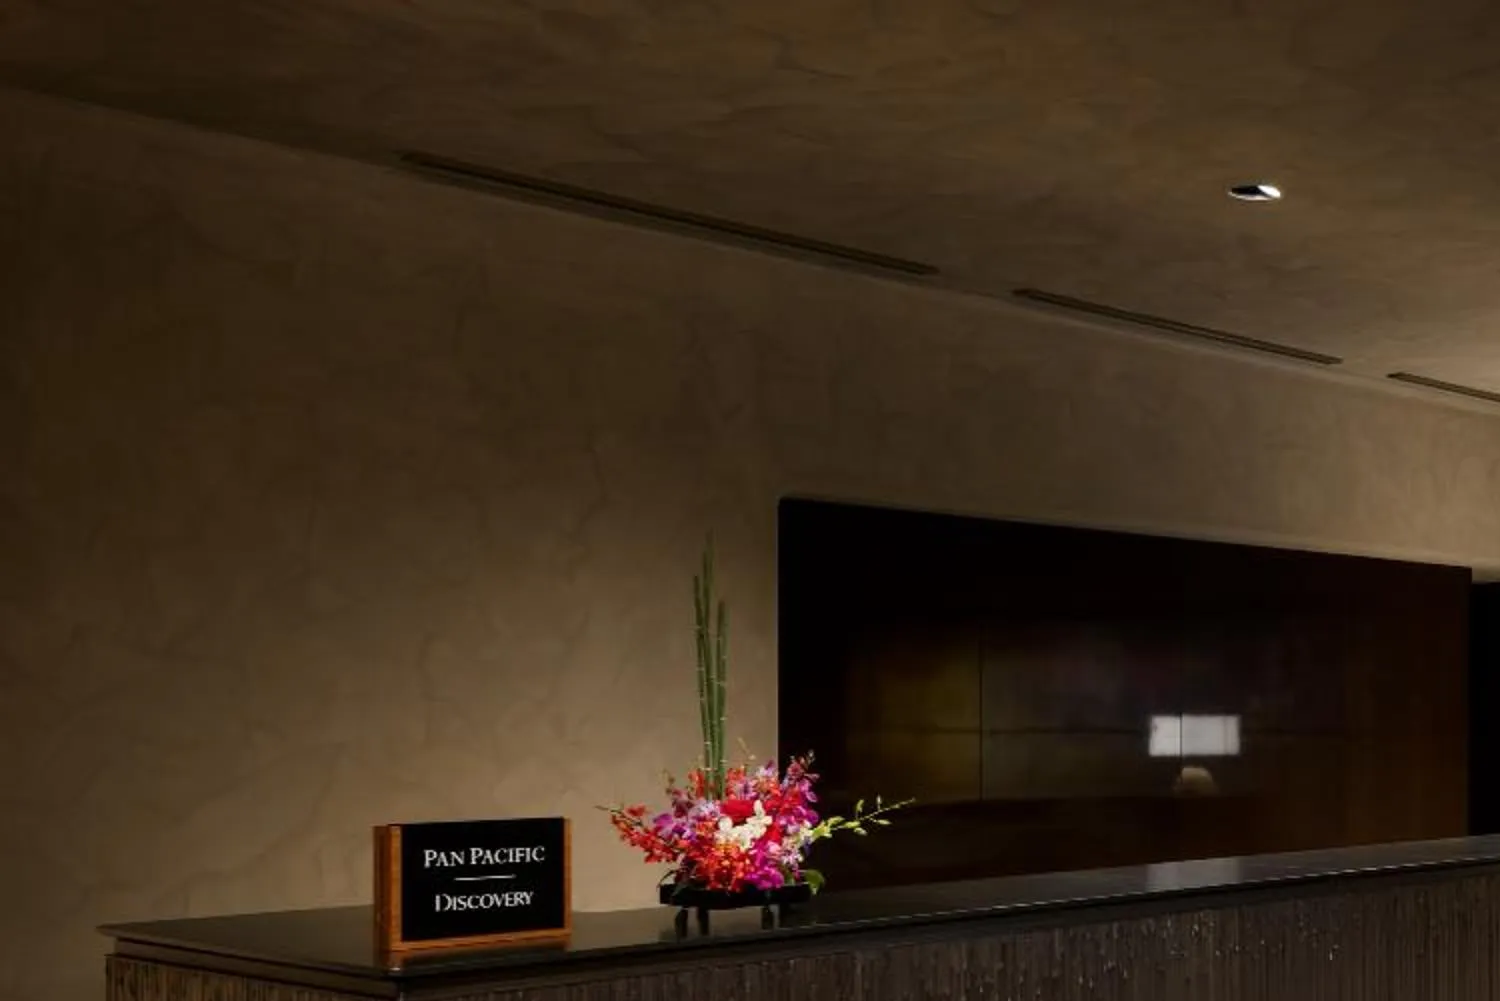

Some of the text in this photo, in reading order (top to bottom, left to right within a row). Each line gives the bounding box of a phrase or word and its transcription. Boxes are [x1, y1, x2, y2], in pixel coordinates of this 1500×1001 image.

[423, 846, 545, 868] PAN PACIFIC
[434, 891, 534, 912] DISCOVERY
